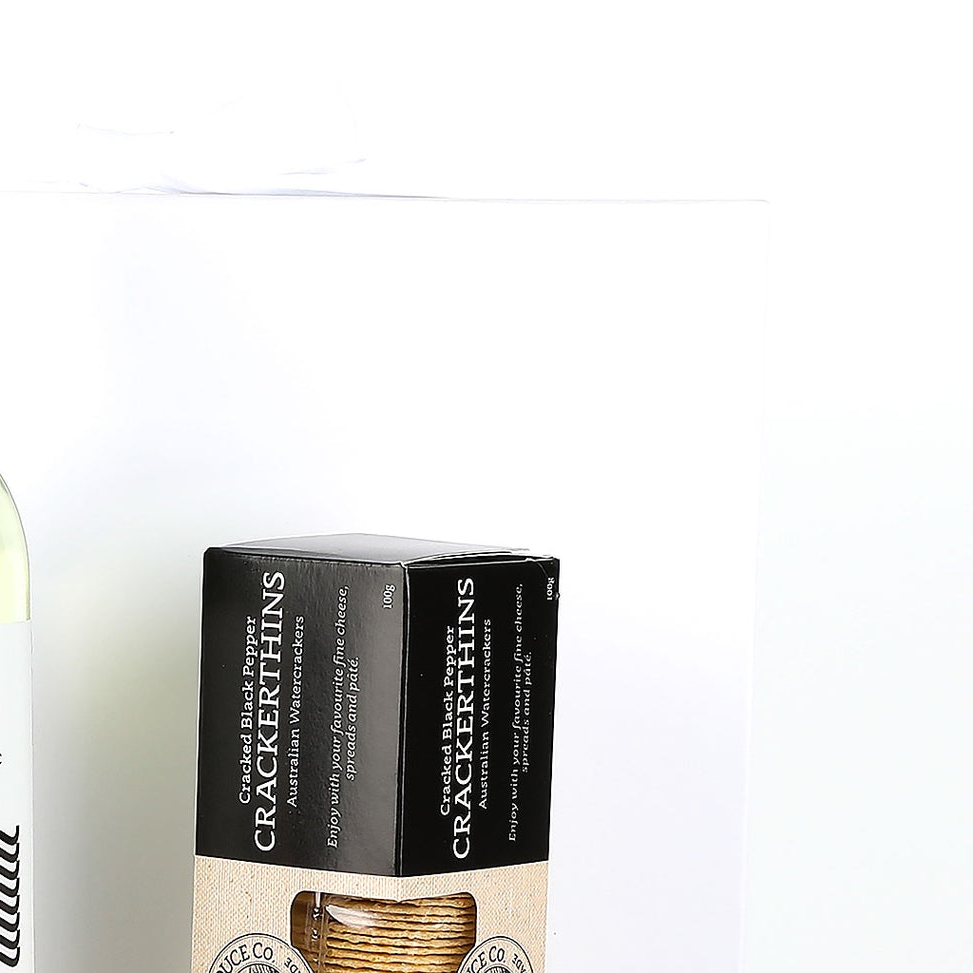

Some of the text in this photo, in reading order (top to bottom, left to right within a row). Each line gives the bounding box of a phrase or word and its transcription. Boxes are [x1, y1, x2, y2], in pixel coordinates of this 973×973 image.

[383, 584, 396, 609] 100g
[239, 616, 258, 804] Cracked Black Pepper
[254, 571, 286, 852] CRACKERTHINS
[287, 615, 305, 807] Australian Watercrackers
[327, 585, 350, 848] Enjoy with your favourite fine cheese,
[345, 657, 361, 781] spreads and pâté.
[440, 625, 457, 816] Cracked Black Pepper
[453, 578, 475, 859] CRACKERTHINS
[479, 618, 492, 810] Australian Watercrackers
[508, 583, 524, 842] Enjoy with your favourite fine cheese,
[522, 720, 531, 773] spreads
[251, 941, 276, 964] CO.
